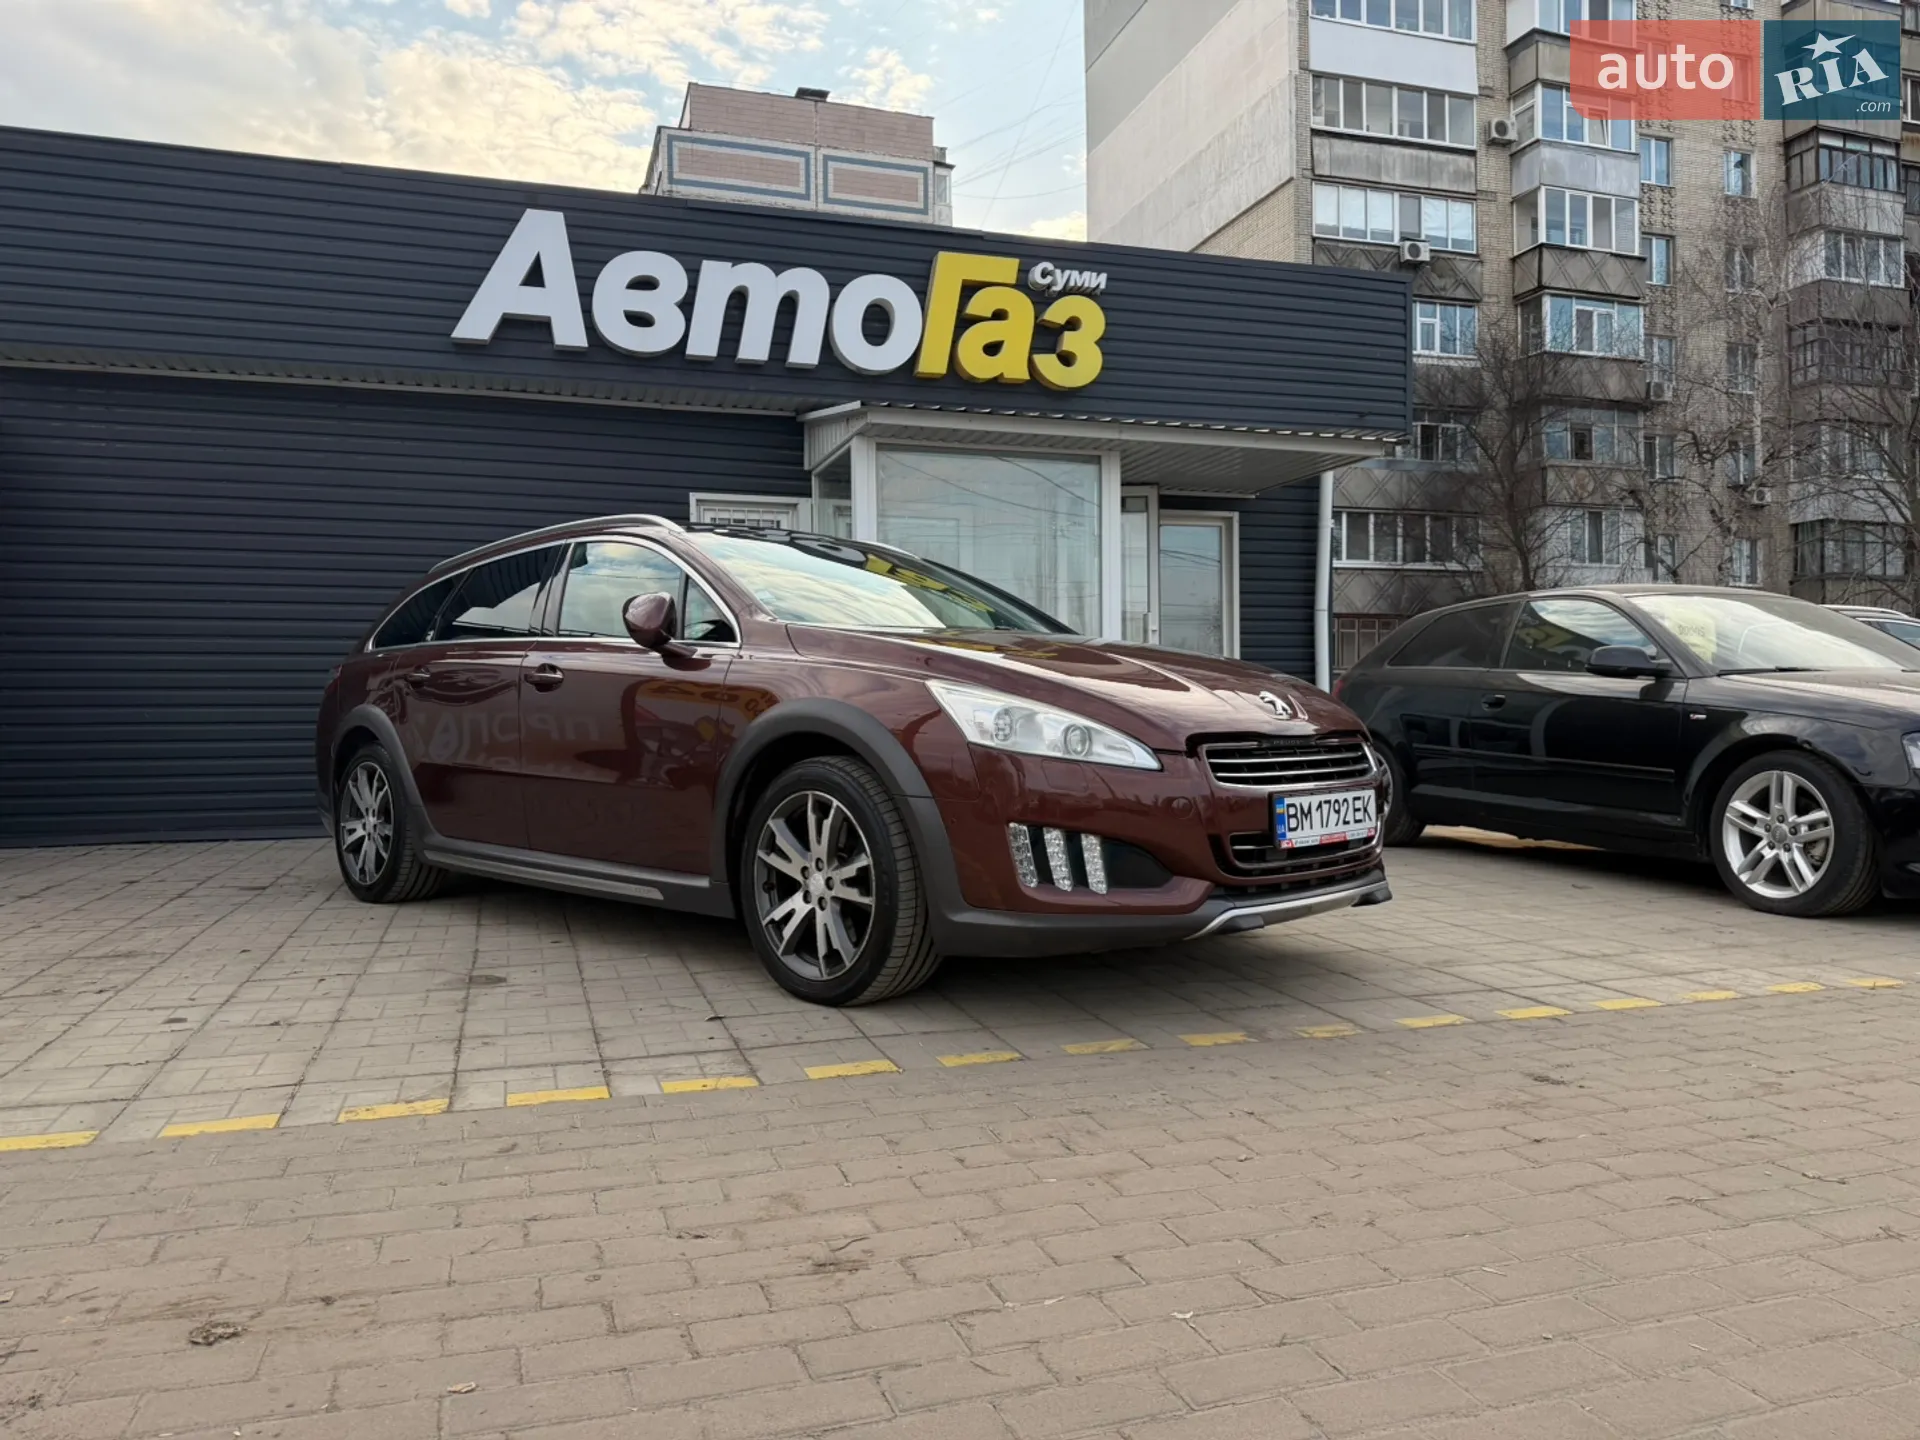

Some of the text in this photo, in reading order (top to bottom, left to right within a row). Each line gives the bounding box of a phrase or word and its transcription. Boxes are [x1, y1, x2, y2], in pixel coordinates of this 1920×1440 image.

[1029, 261, 1108, 293] Суми
[1286, 795, 1372, 832] BM 1792 EK
